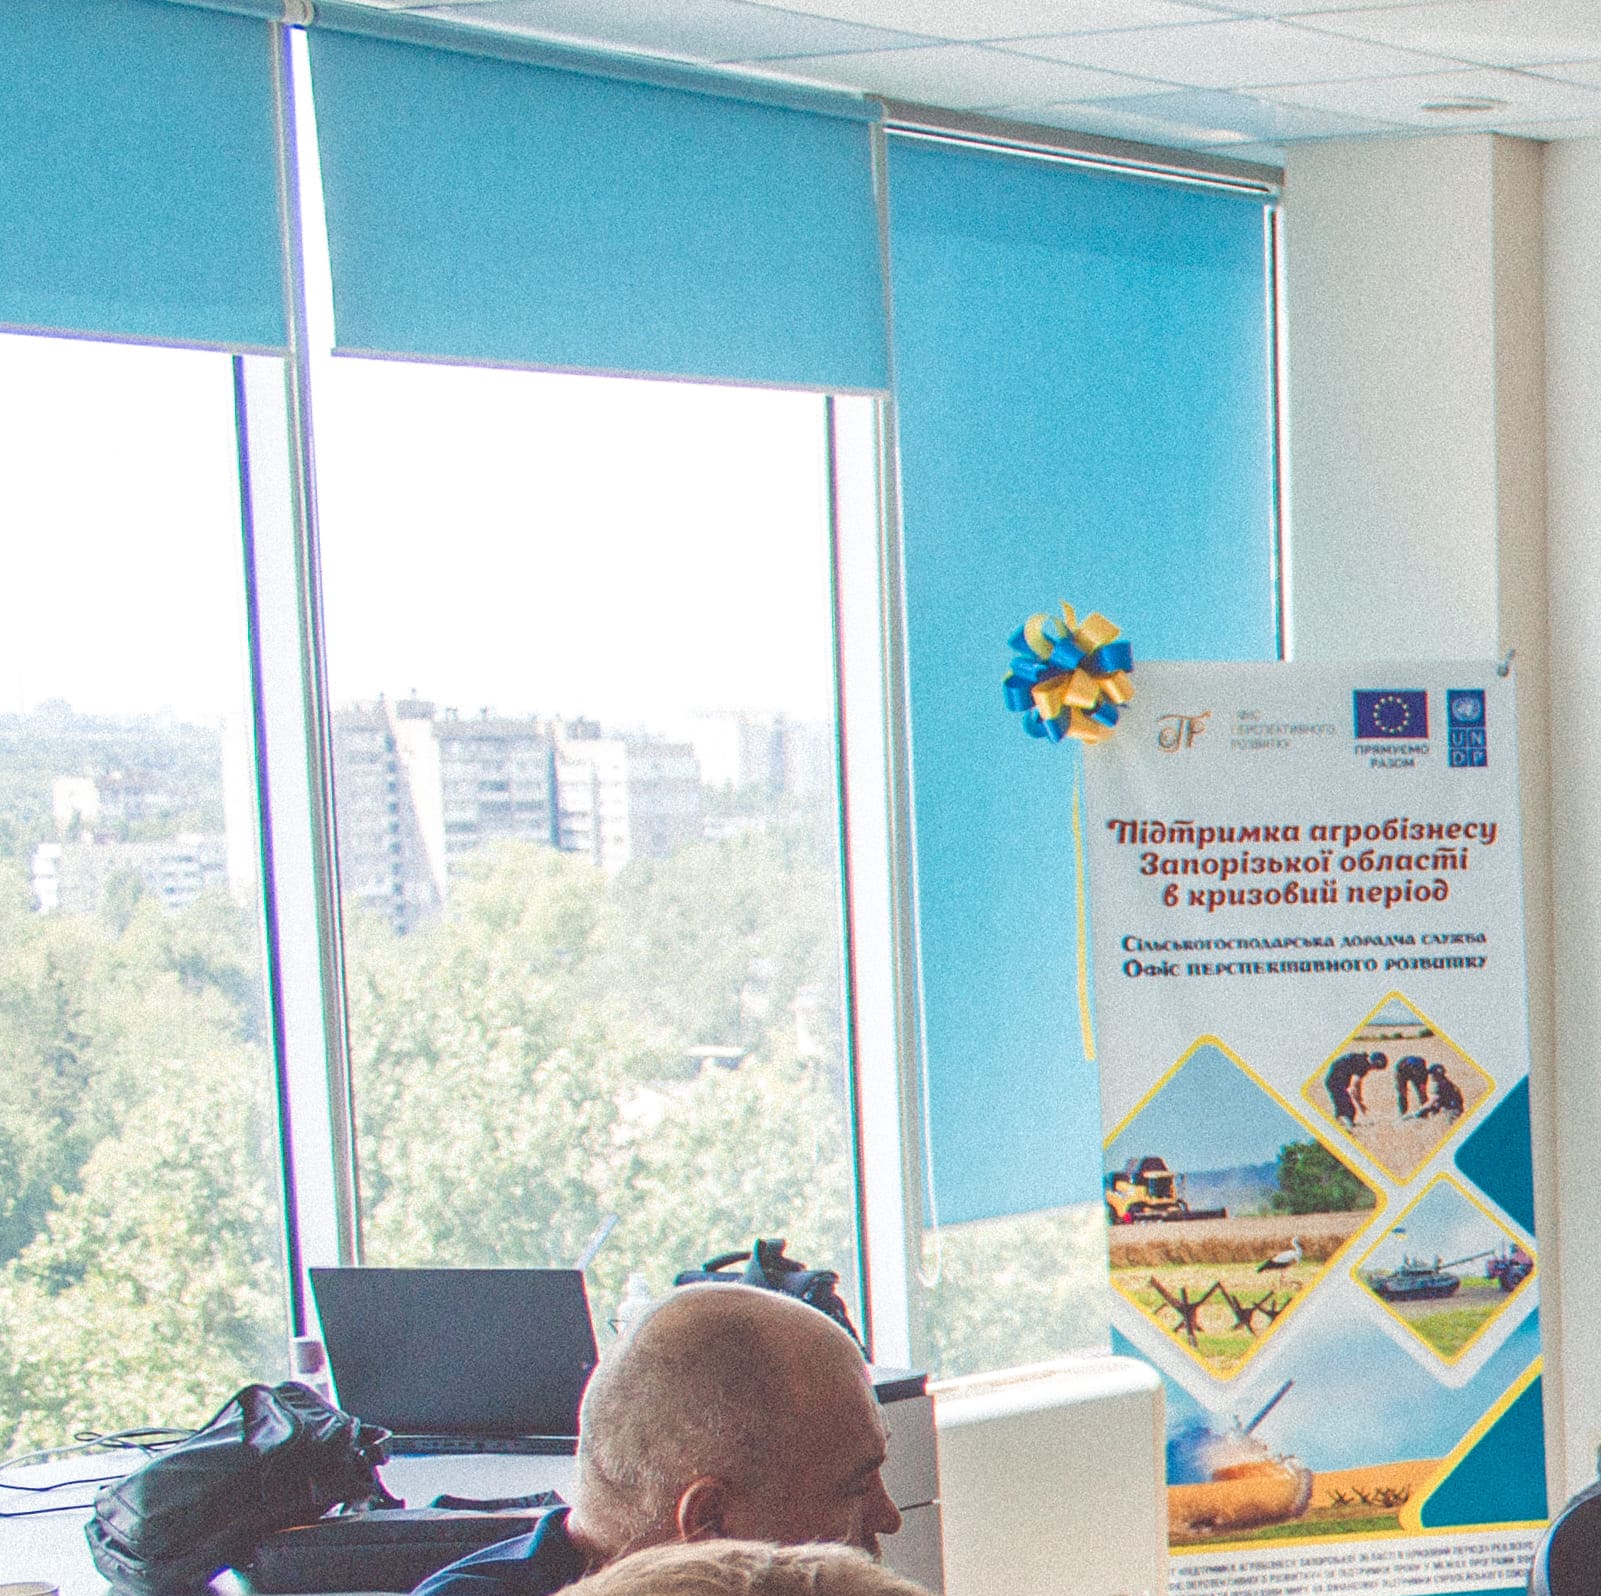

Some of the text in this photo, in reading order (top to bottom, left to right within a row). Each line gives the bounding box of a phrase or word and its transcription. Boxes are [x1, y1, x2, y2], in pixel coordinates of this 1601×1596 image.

[1370, 756, 1415, 769] РАЗОМ
[1107, 817, 1498, 850] Підтримка агробізнесу
[1139, 847, 1469, 881] Запорізької області
[1163, 877, 1450, 913] в кризовий період
